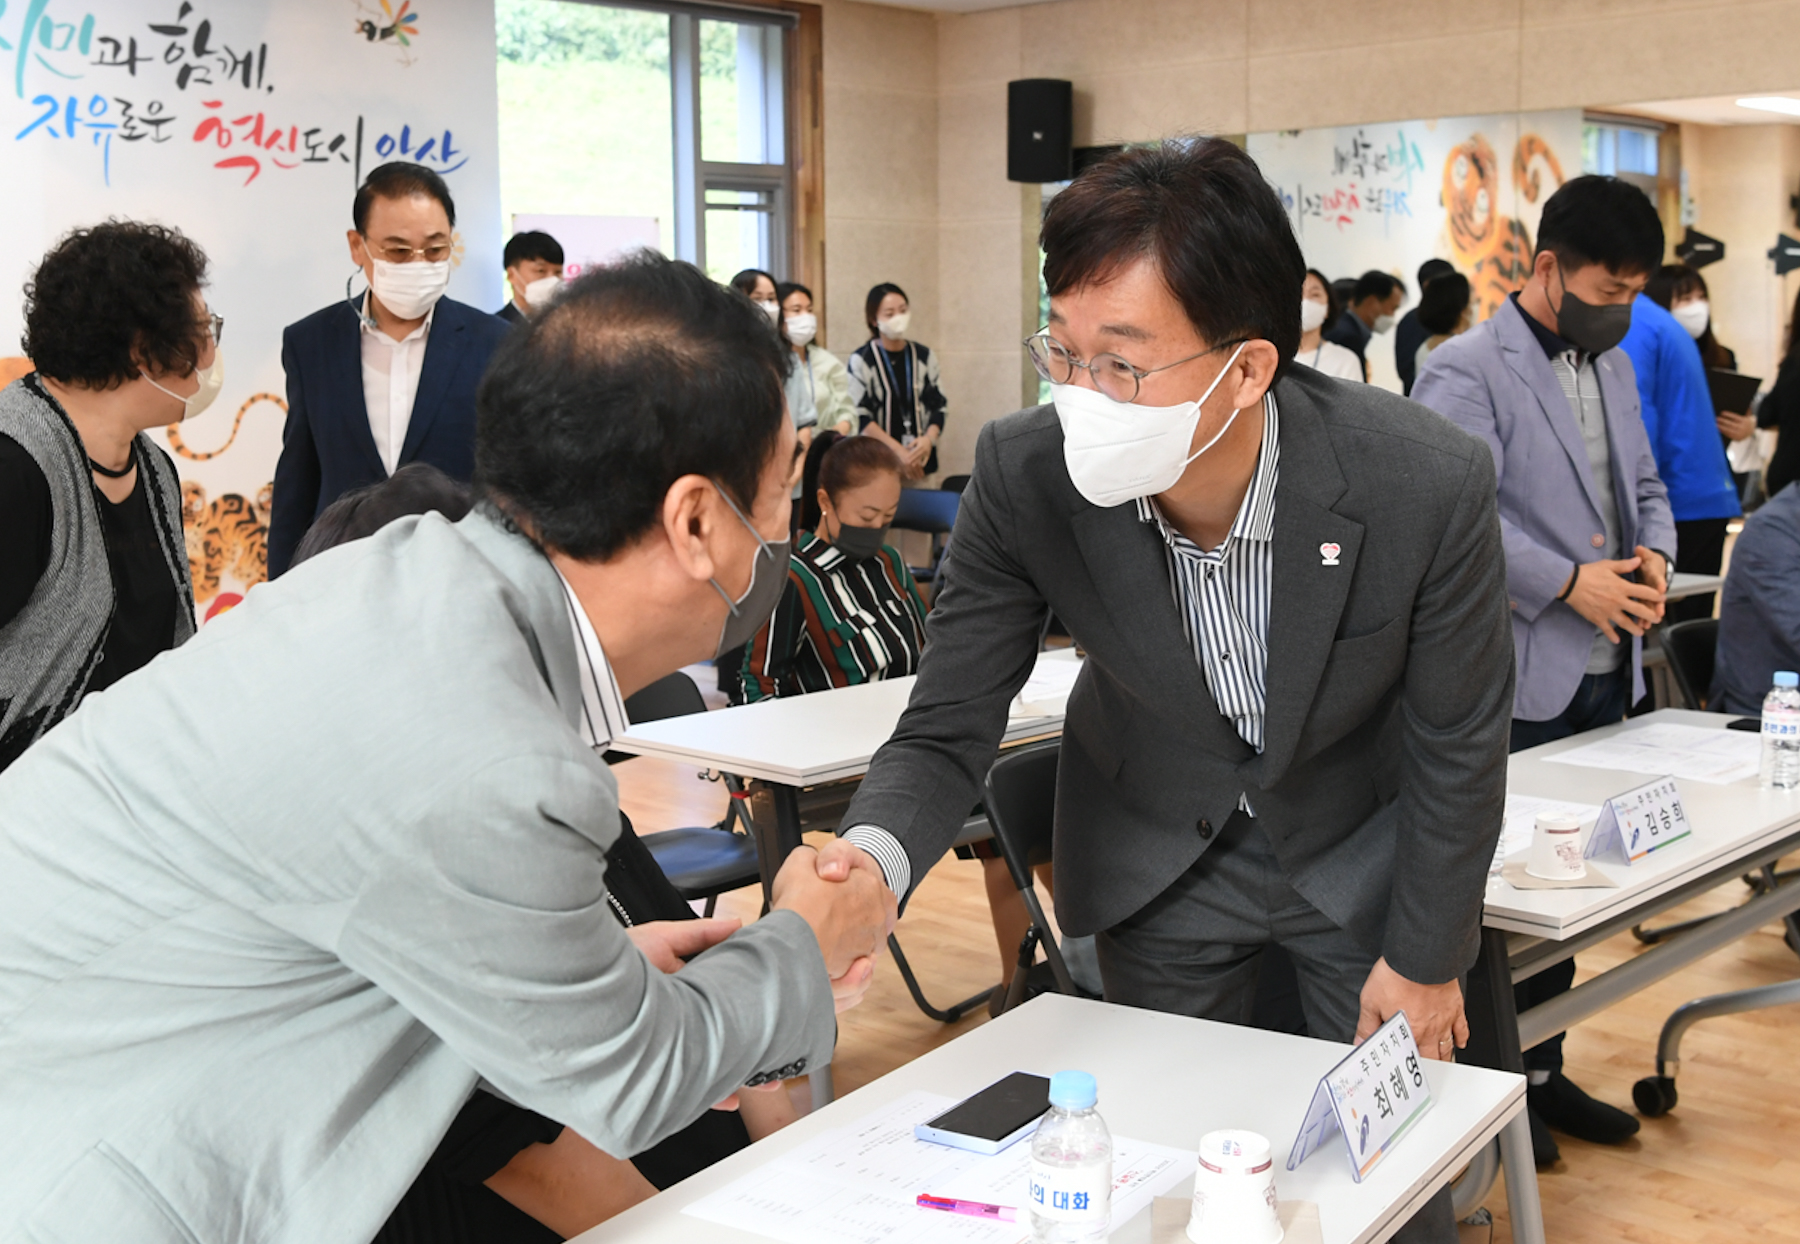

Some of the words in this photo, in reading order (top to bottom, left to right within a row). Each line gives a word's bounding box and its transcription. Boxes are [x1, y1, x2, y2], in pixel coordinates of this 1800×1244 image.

[15, 93, 177, 188] 자유로운
[193, 100, 364, 192] 혁신도시
[1644, 800, 1686, 836] 김승희
[1360, 1022, 1410, 1077] 주민자치회
[1373, 1050, 1423, 1119] 최혜영
[1053, 1190, 1091, 1211] 대화
